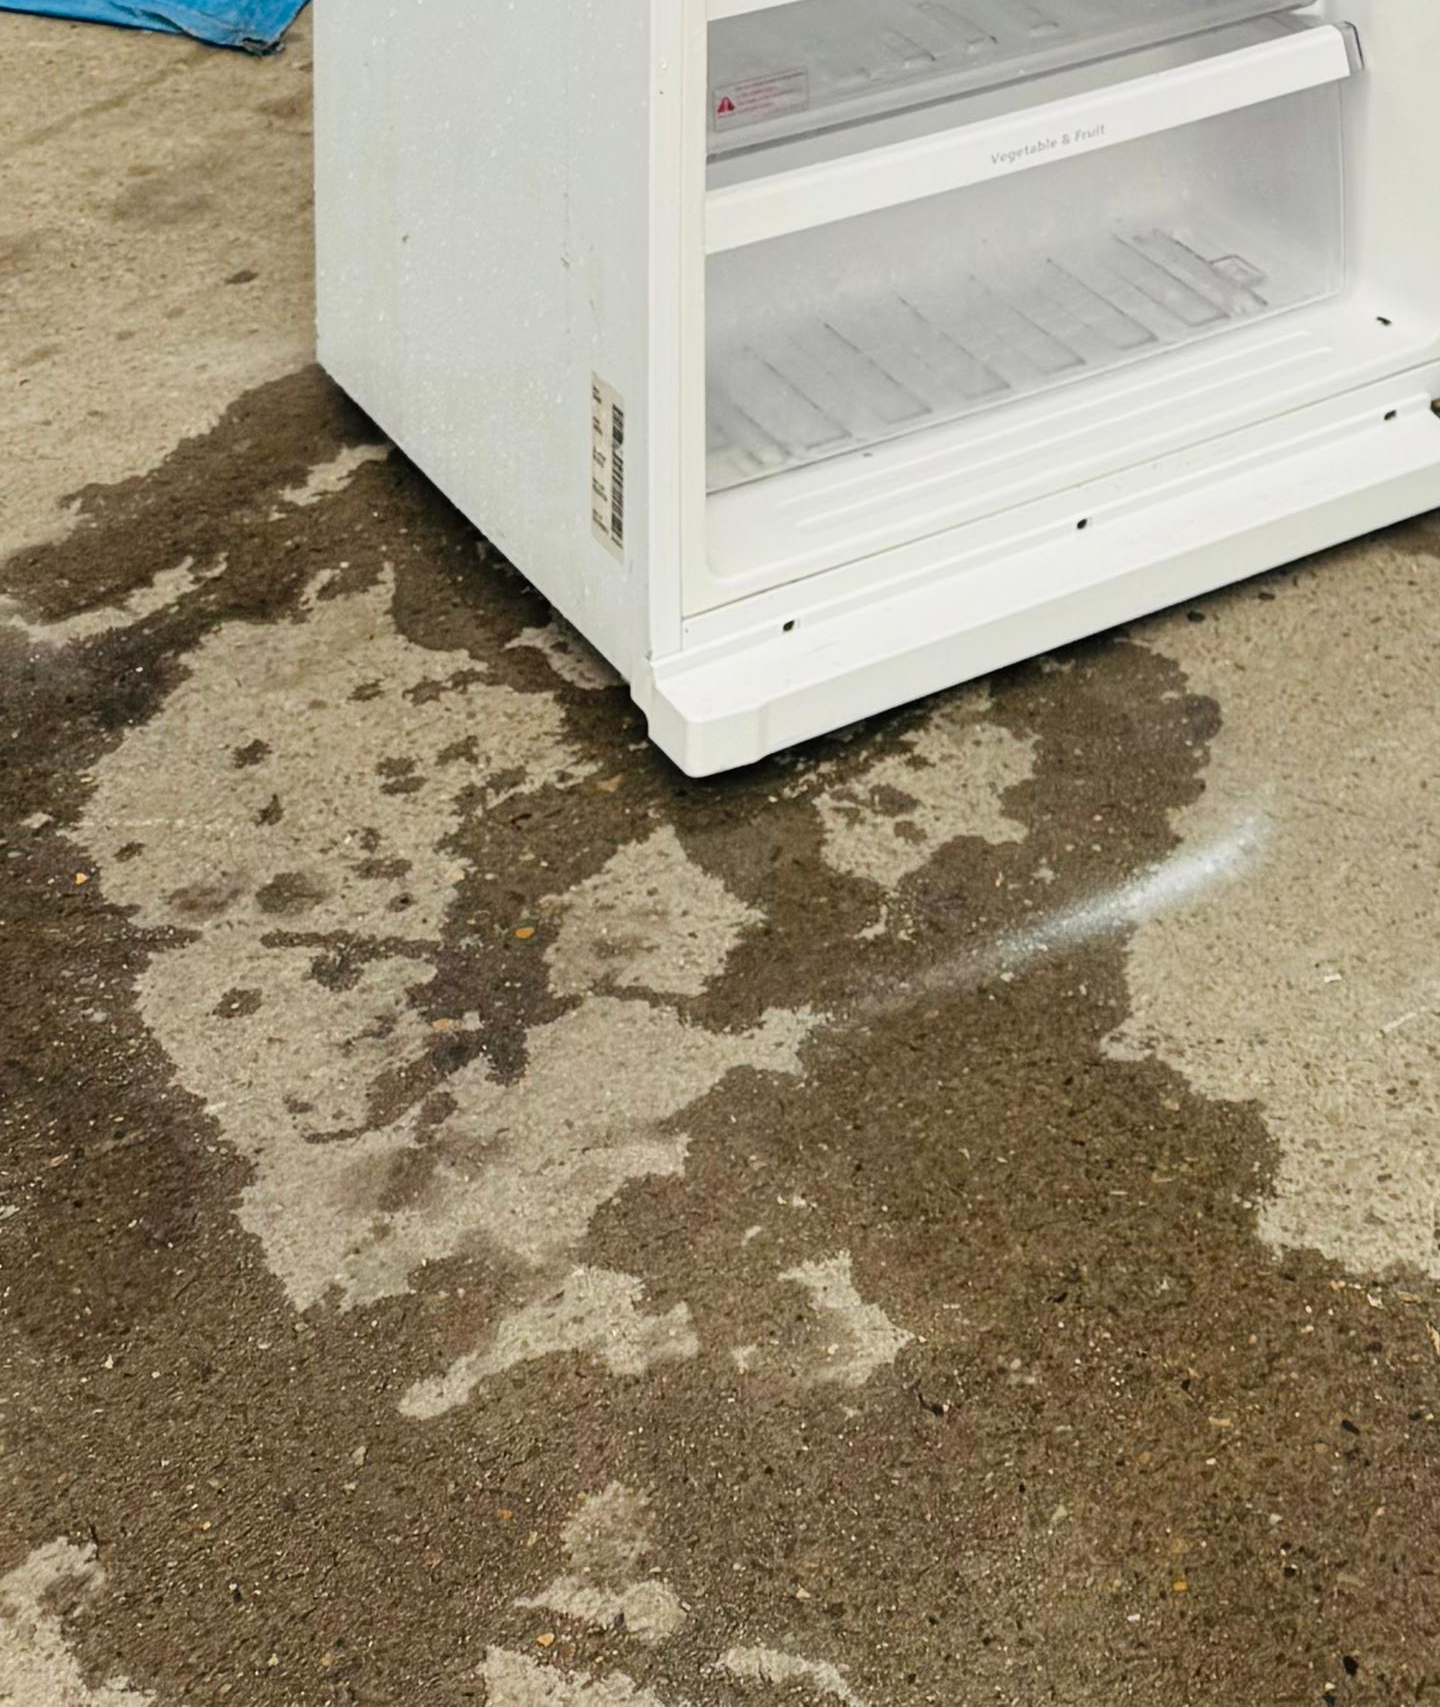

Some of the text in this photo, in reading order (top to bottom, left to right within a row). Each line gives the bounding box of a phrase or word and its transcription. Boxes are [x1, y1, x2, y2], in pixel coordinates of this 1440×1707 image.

[990, 124, 1105, 164] Vegetable & Fruit
